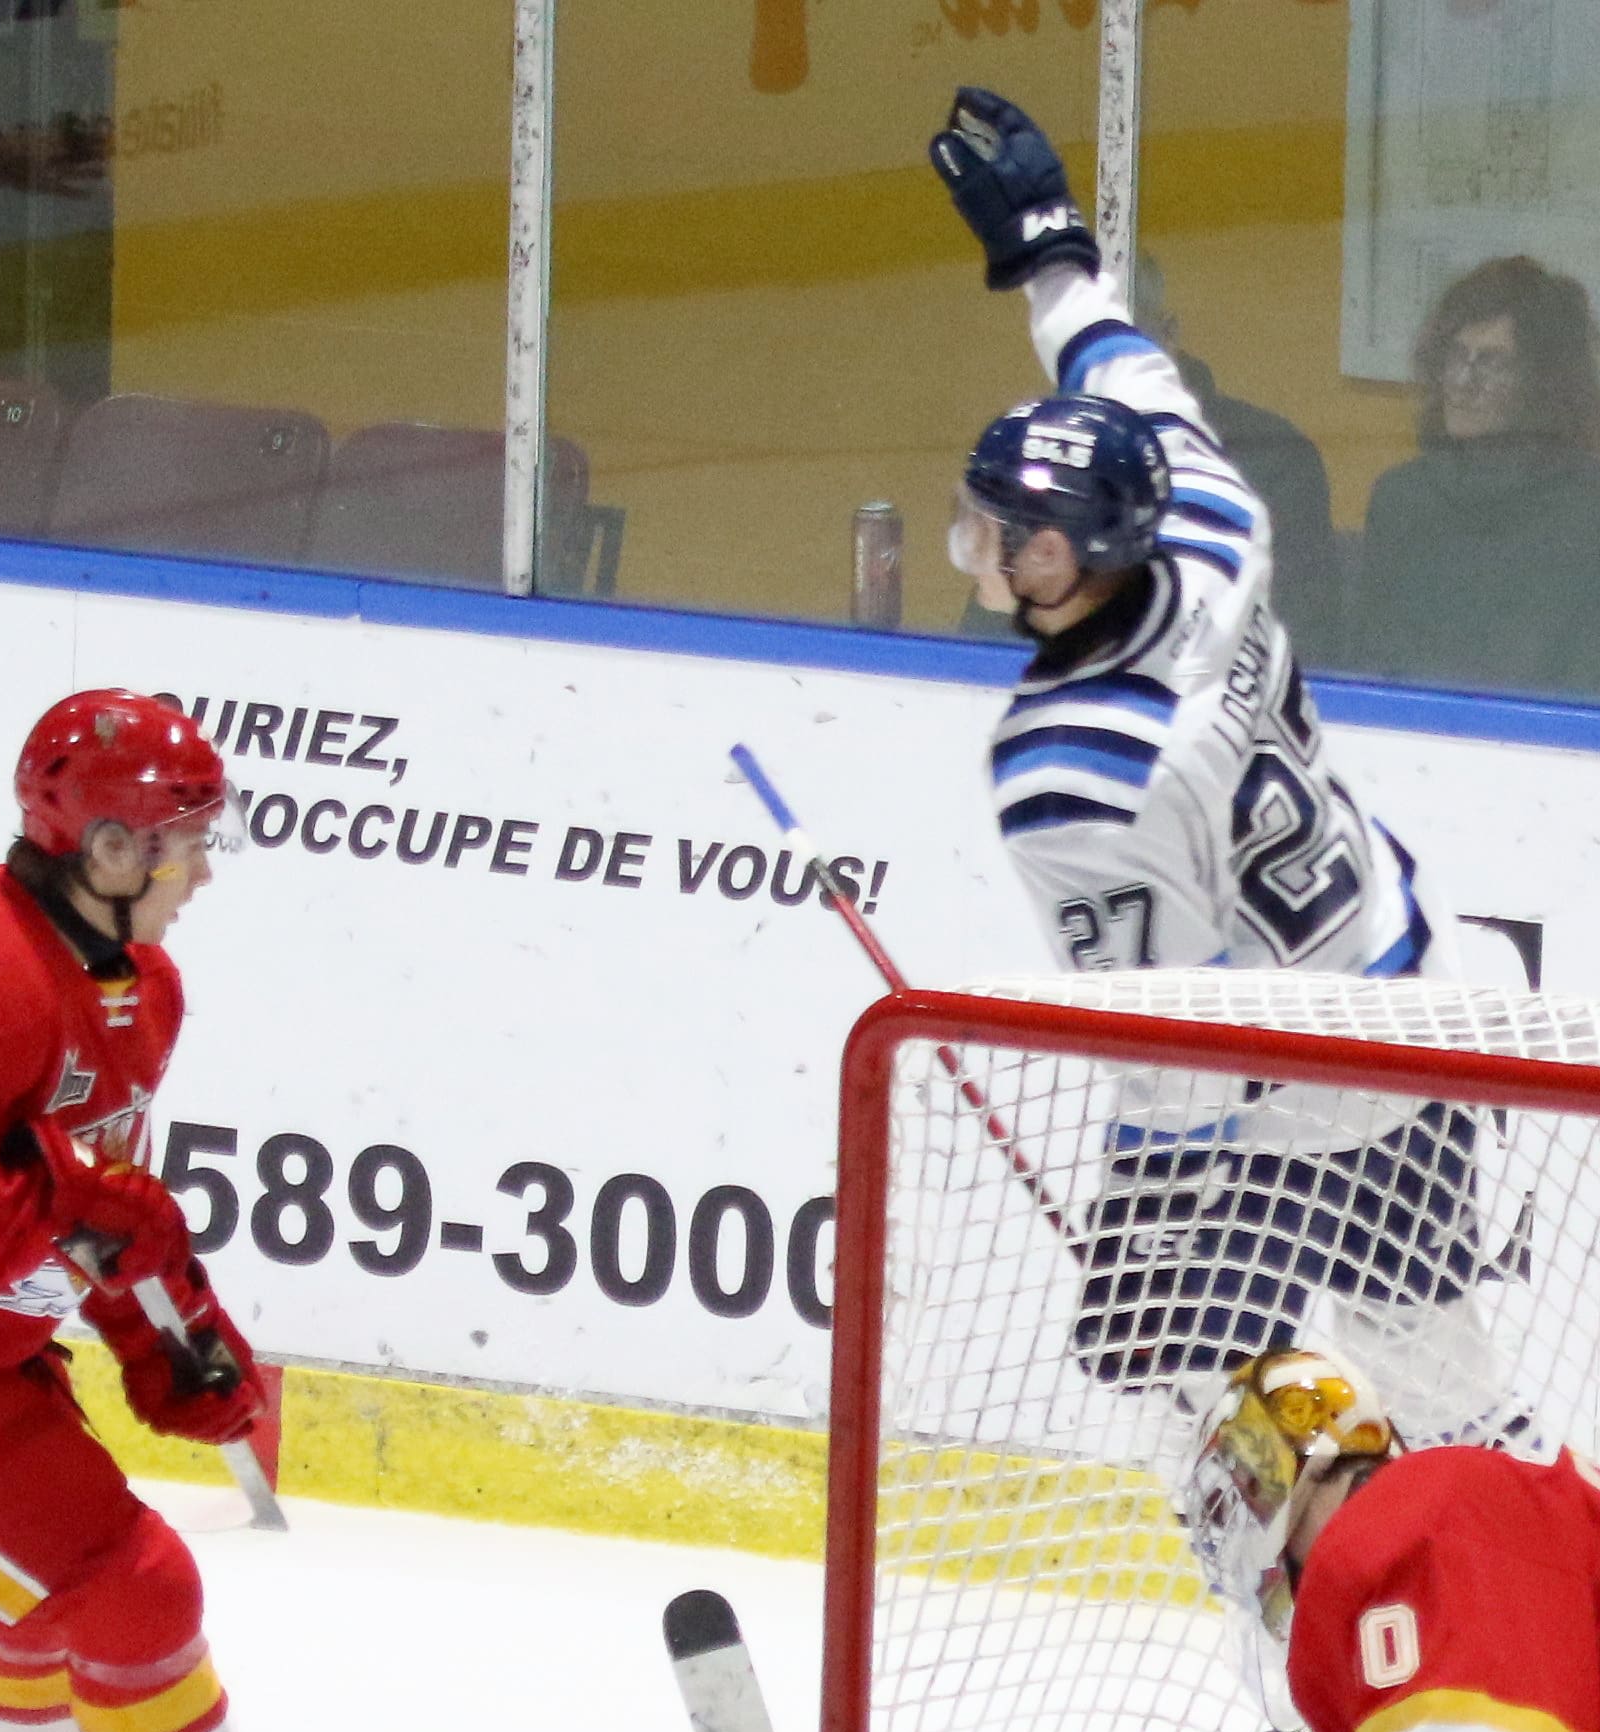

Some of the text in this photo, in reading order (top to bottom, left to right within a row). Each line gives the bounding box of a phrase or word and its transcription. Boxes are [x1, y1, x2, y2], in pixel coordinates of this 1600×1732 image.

[7, 406, 22, 423] 10
[152, 690, 409, 788] URIEZ,
[238, 787, 890, 915] 'OCCUPE DE VOUS!
[1057, 880, 1155, 970] 27
